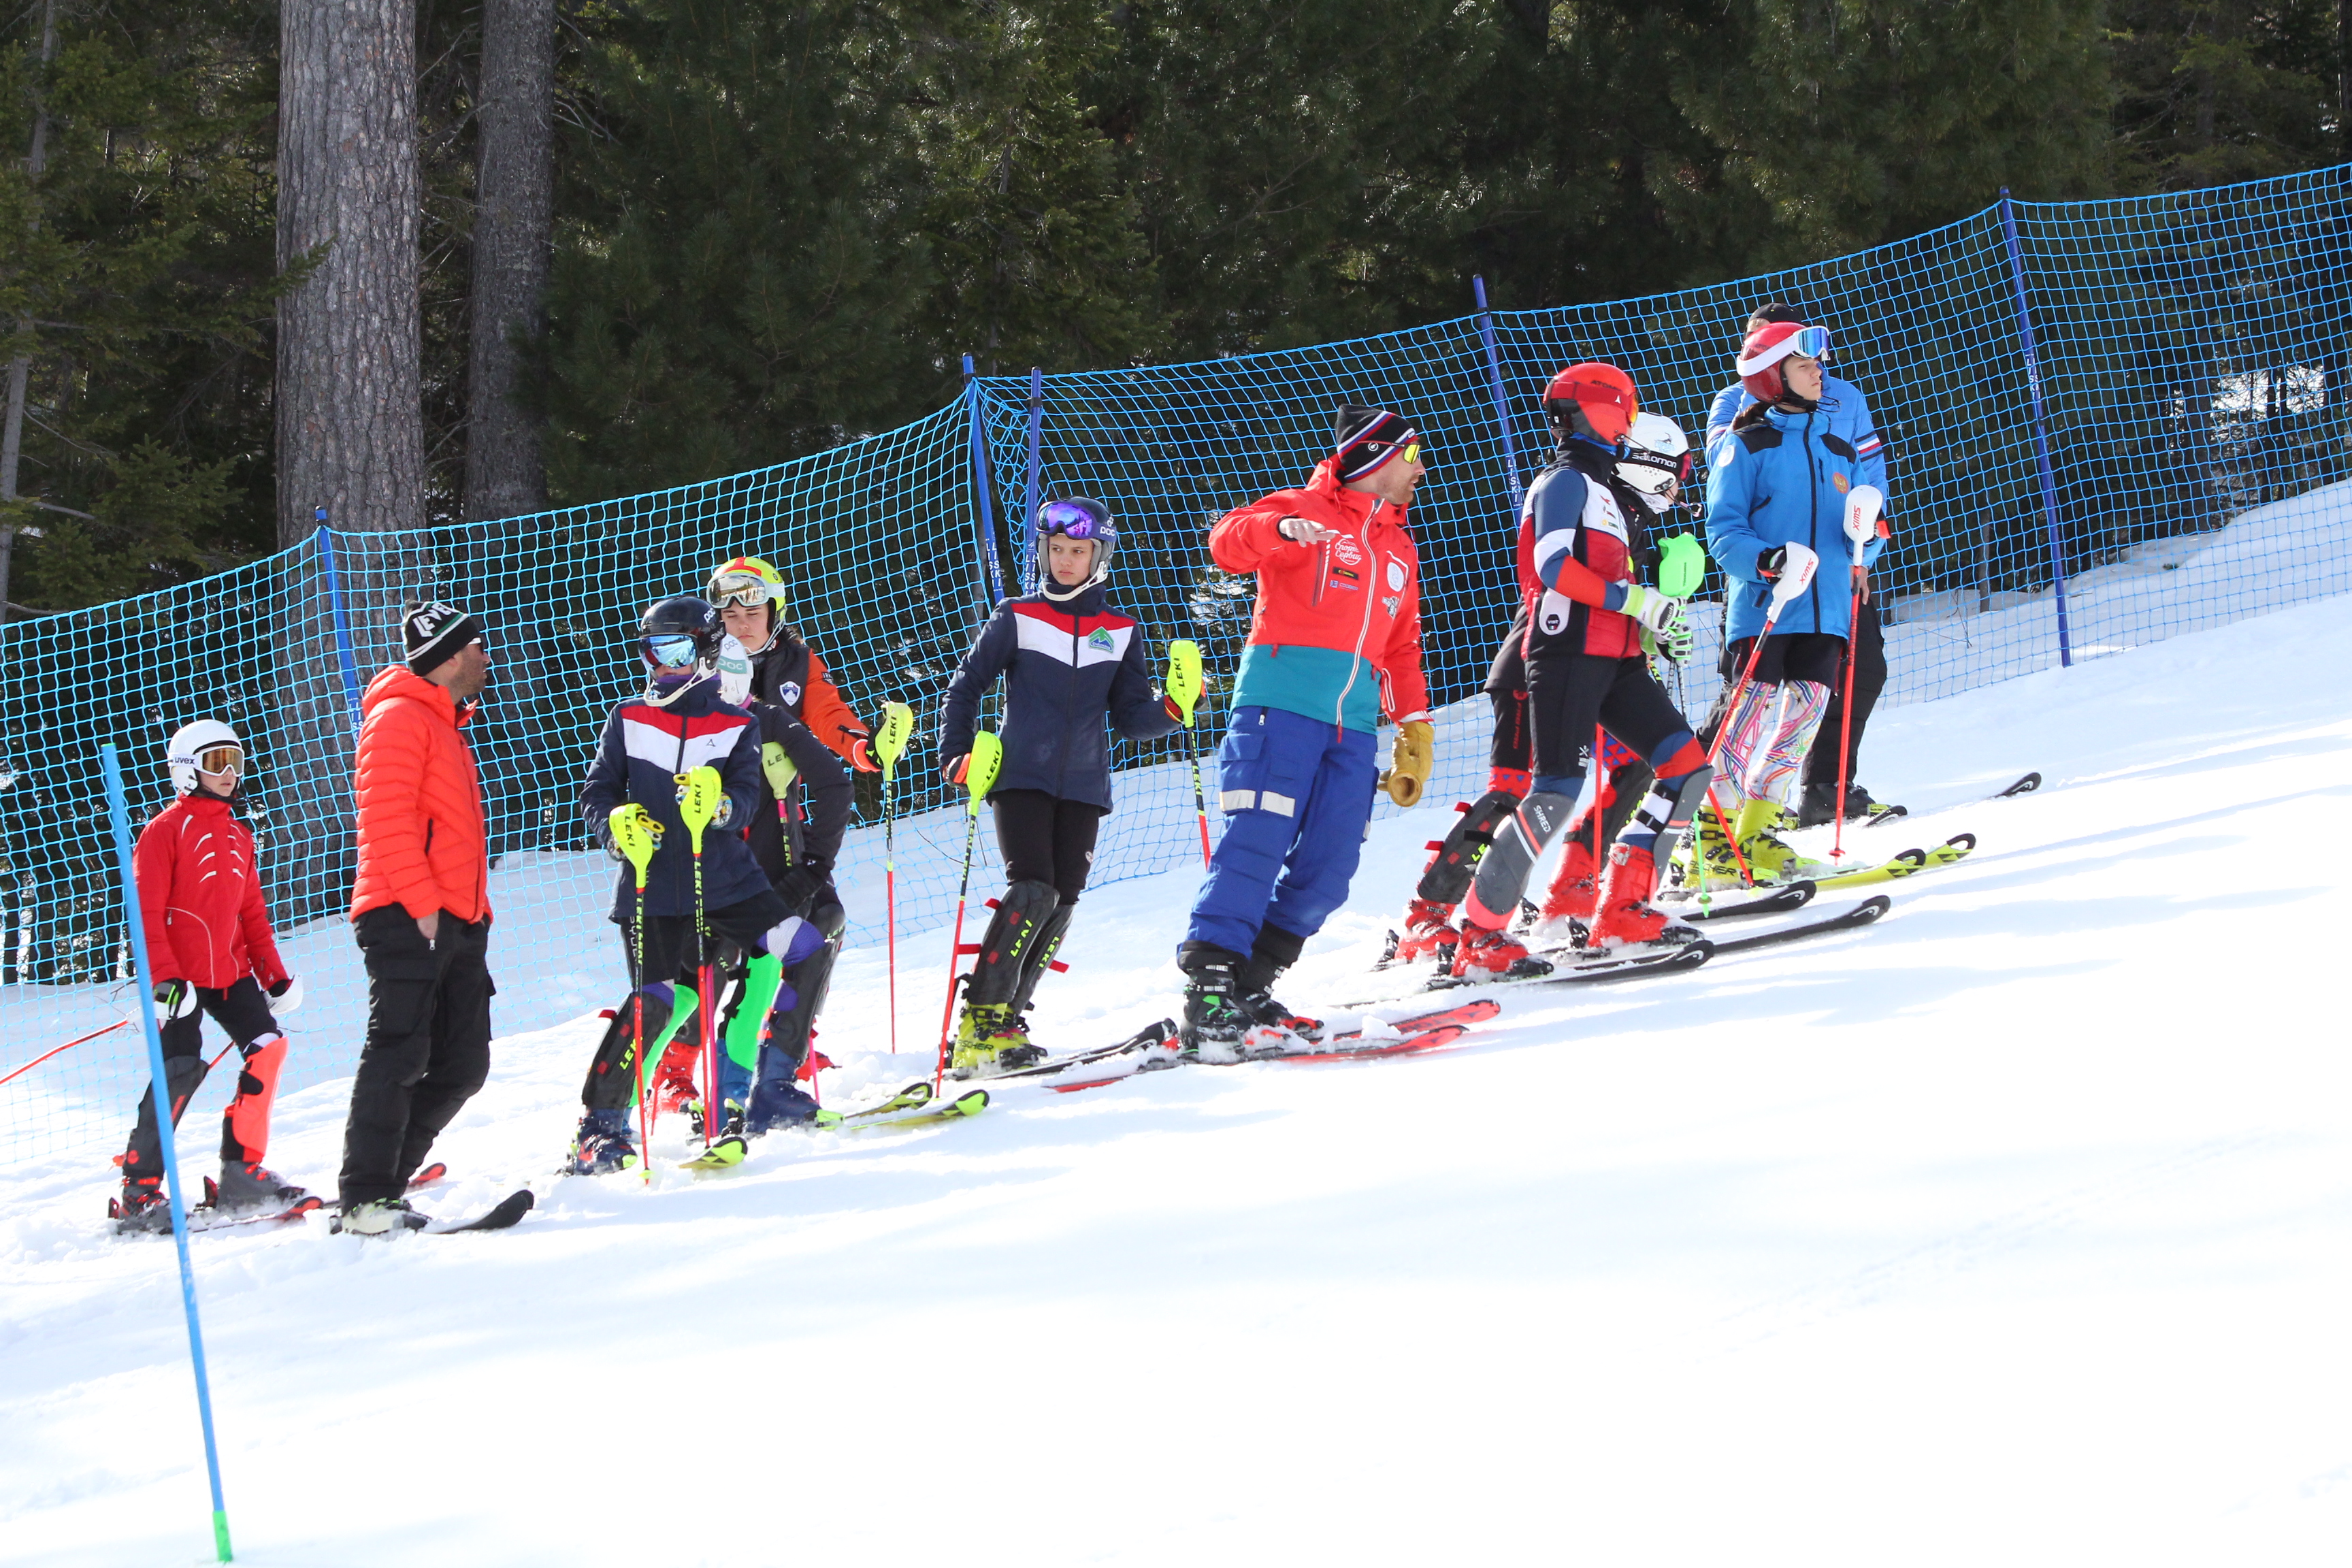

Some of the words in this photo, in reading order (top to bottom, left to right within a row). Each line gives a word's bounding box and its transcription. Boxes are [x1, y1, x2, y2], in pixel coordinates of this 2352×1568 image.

[1507, 459, 1518, 502] LISKI
[1100, 526, 1115, 537] poc
[1852, 504, 1861, 532] SWIX
[992, 542, 1002, 587] LISKI
[1799, 557, 1814, 586] SWIX
[412, 602, 453, 638] LEVE
[703, 608, 716, 623] poc
[723, 639, 738, 651] poc
[1174, 657, 1185, 687] LEKI
[889, 715, 897, 745] LEKI
[174, 756, 196, 764] uvex
[985, 750, 1000, 781] LEKI
[1192, 765, 1203, 796] LEKI
[693, 783, 702, 814] LEKI
[624, 815, 636, 847] LEKI
[1533, 804, 1552, 832] SHRED
[783, 835, 793, 867] LEKI
[693, 861, 702, 896] LEKI
[1009, 919, 1033, 958] LEKI
[1039, 936, 1060, 968] LEKI
[619, 1036, 644, 1071] LEK
